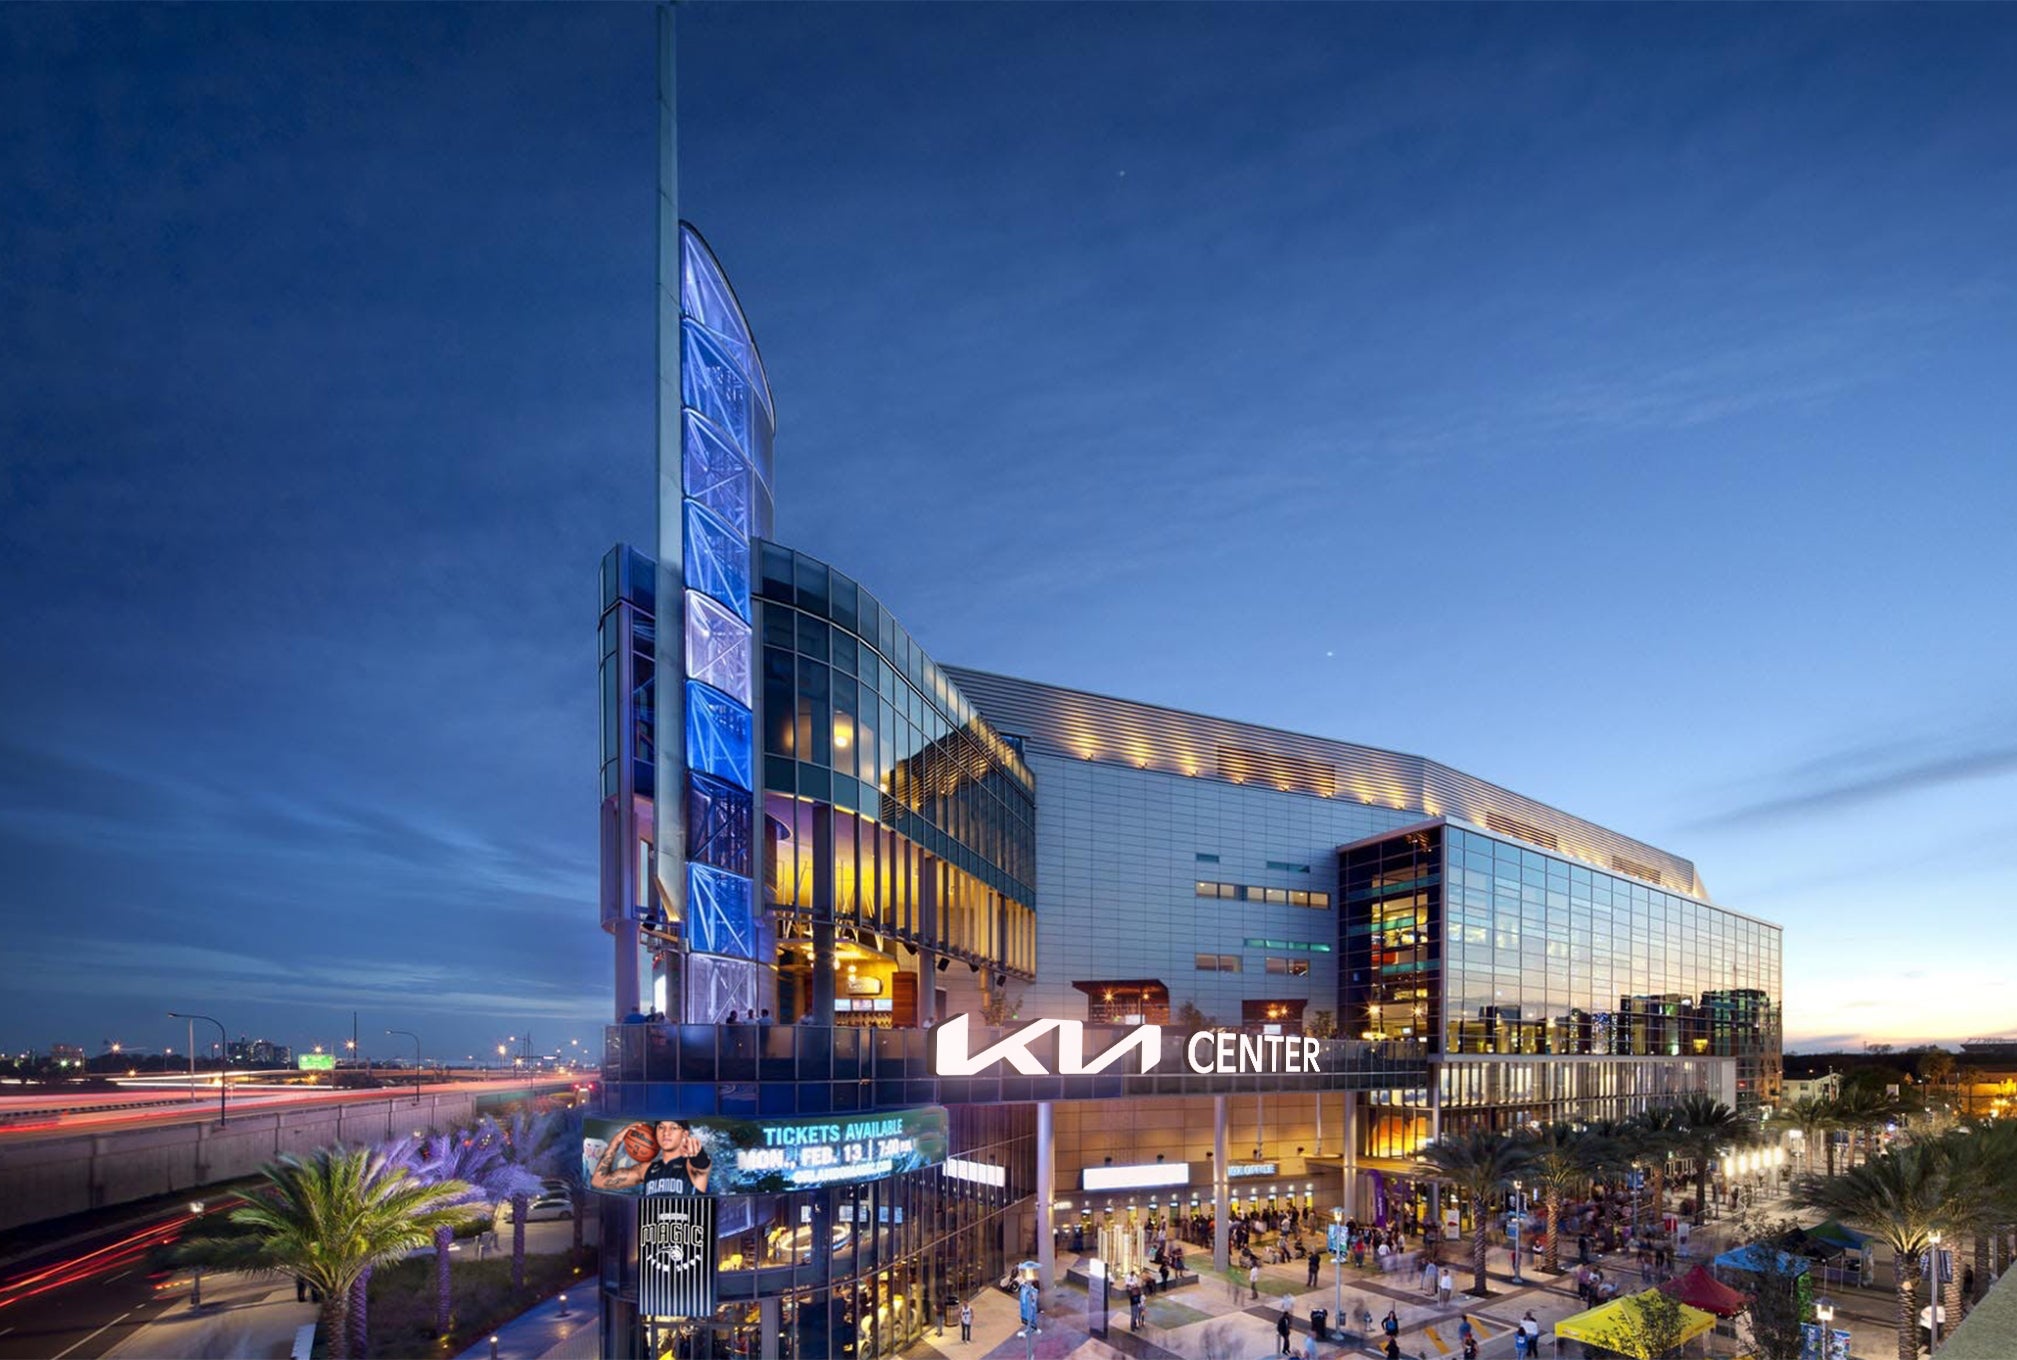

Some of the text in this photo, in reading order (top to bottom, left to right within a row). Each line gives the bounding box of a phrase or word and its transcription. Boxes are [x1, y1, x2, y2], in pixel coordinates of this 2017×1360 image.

[935, 1013, 1321, 1076] KIA CENTER
[763, 1118, 903, 1146] TICKETS AVAILABLE
[802, 1146, 838, 1167] FEB.
[843, 1143, 862, 1163] 13
[641, 1222, 704, 1248] MAGIC
